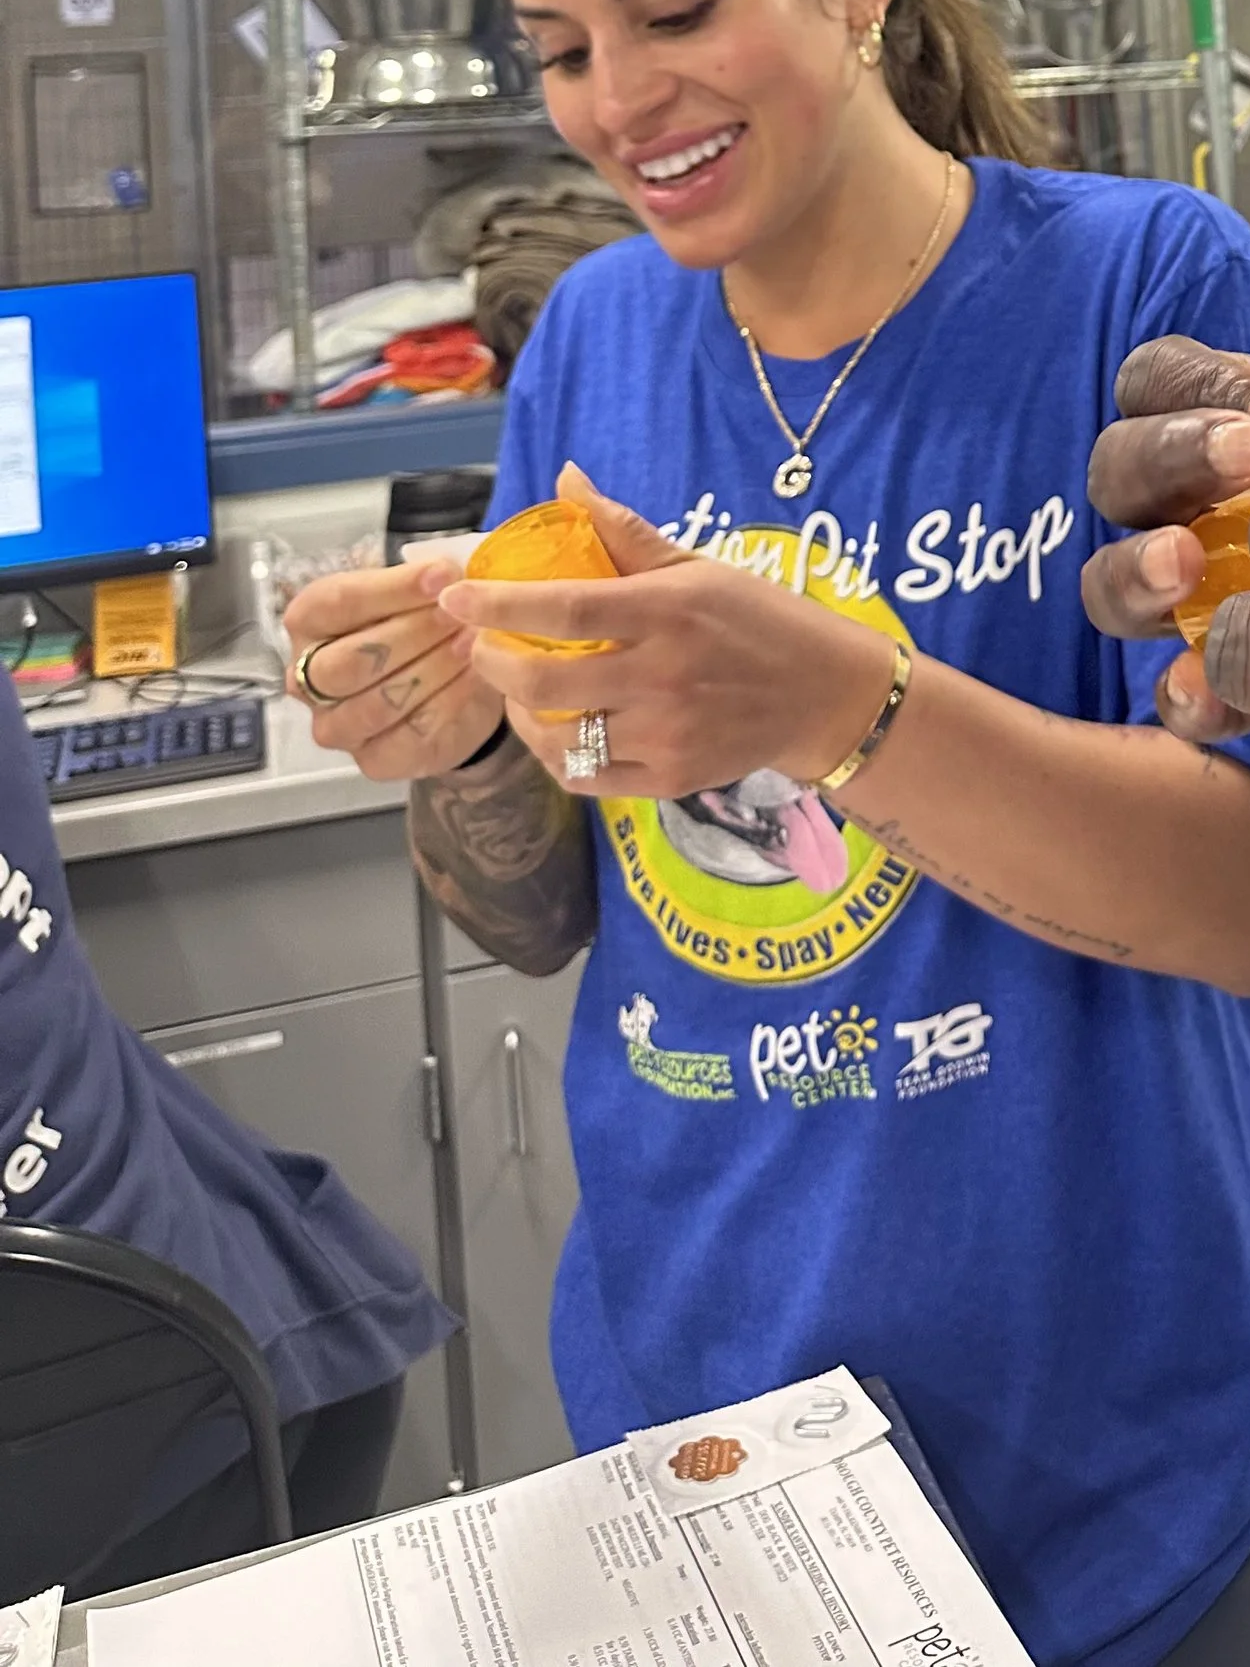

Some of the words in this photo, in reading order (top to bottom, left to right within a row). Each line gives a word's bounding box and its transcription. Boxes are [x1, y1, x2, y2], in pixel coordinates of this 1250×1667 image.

[657, 492, 786, 583] tion
[791, 510, 881, 601] Pit
[893, 495, 1075, 602] Stop
[615, 814, 655, 903] Save
[657, 896, 730, 966] Lives
[755, 925, 835, 973] Spay
[843, 856, 909, 931] Neu
[749, 1010, 839, 1103] pet
[791, 1081, 873, 1110] CENTER
[806, 1560, 831, 1597] MEDICAL
[825, 1595, 851, 1633] HISTORY
[853, 1493, 888, 1538] COUNTY
[878, 1534, 901, 1559] PET
[890, 1554, 938, 1620] RESOURCES
[823, 1629, 841, 1654] CLINIC
[888, 1622, 971, 1667] pet
